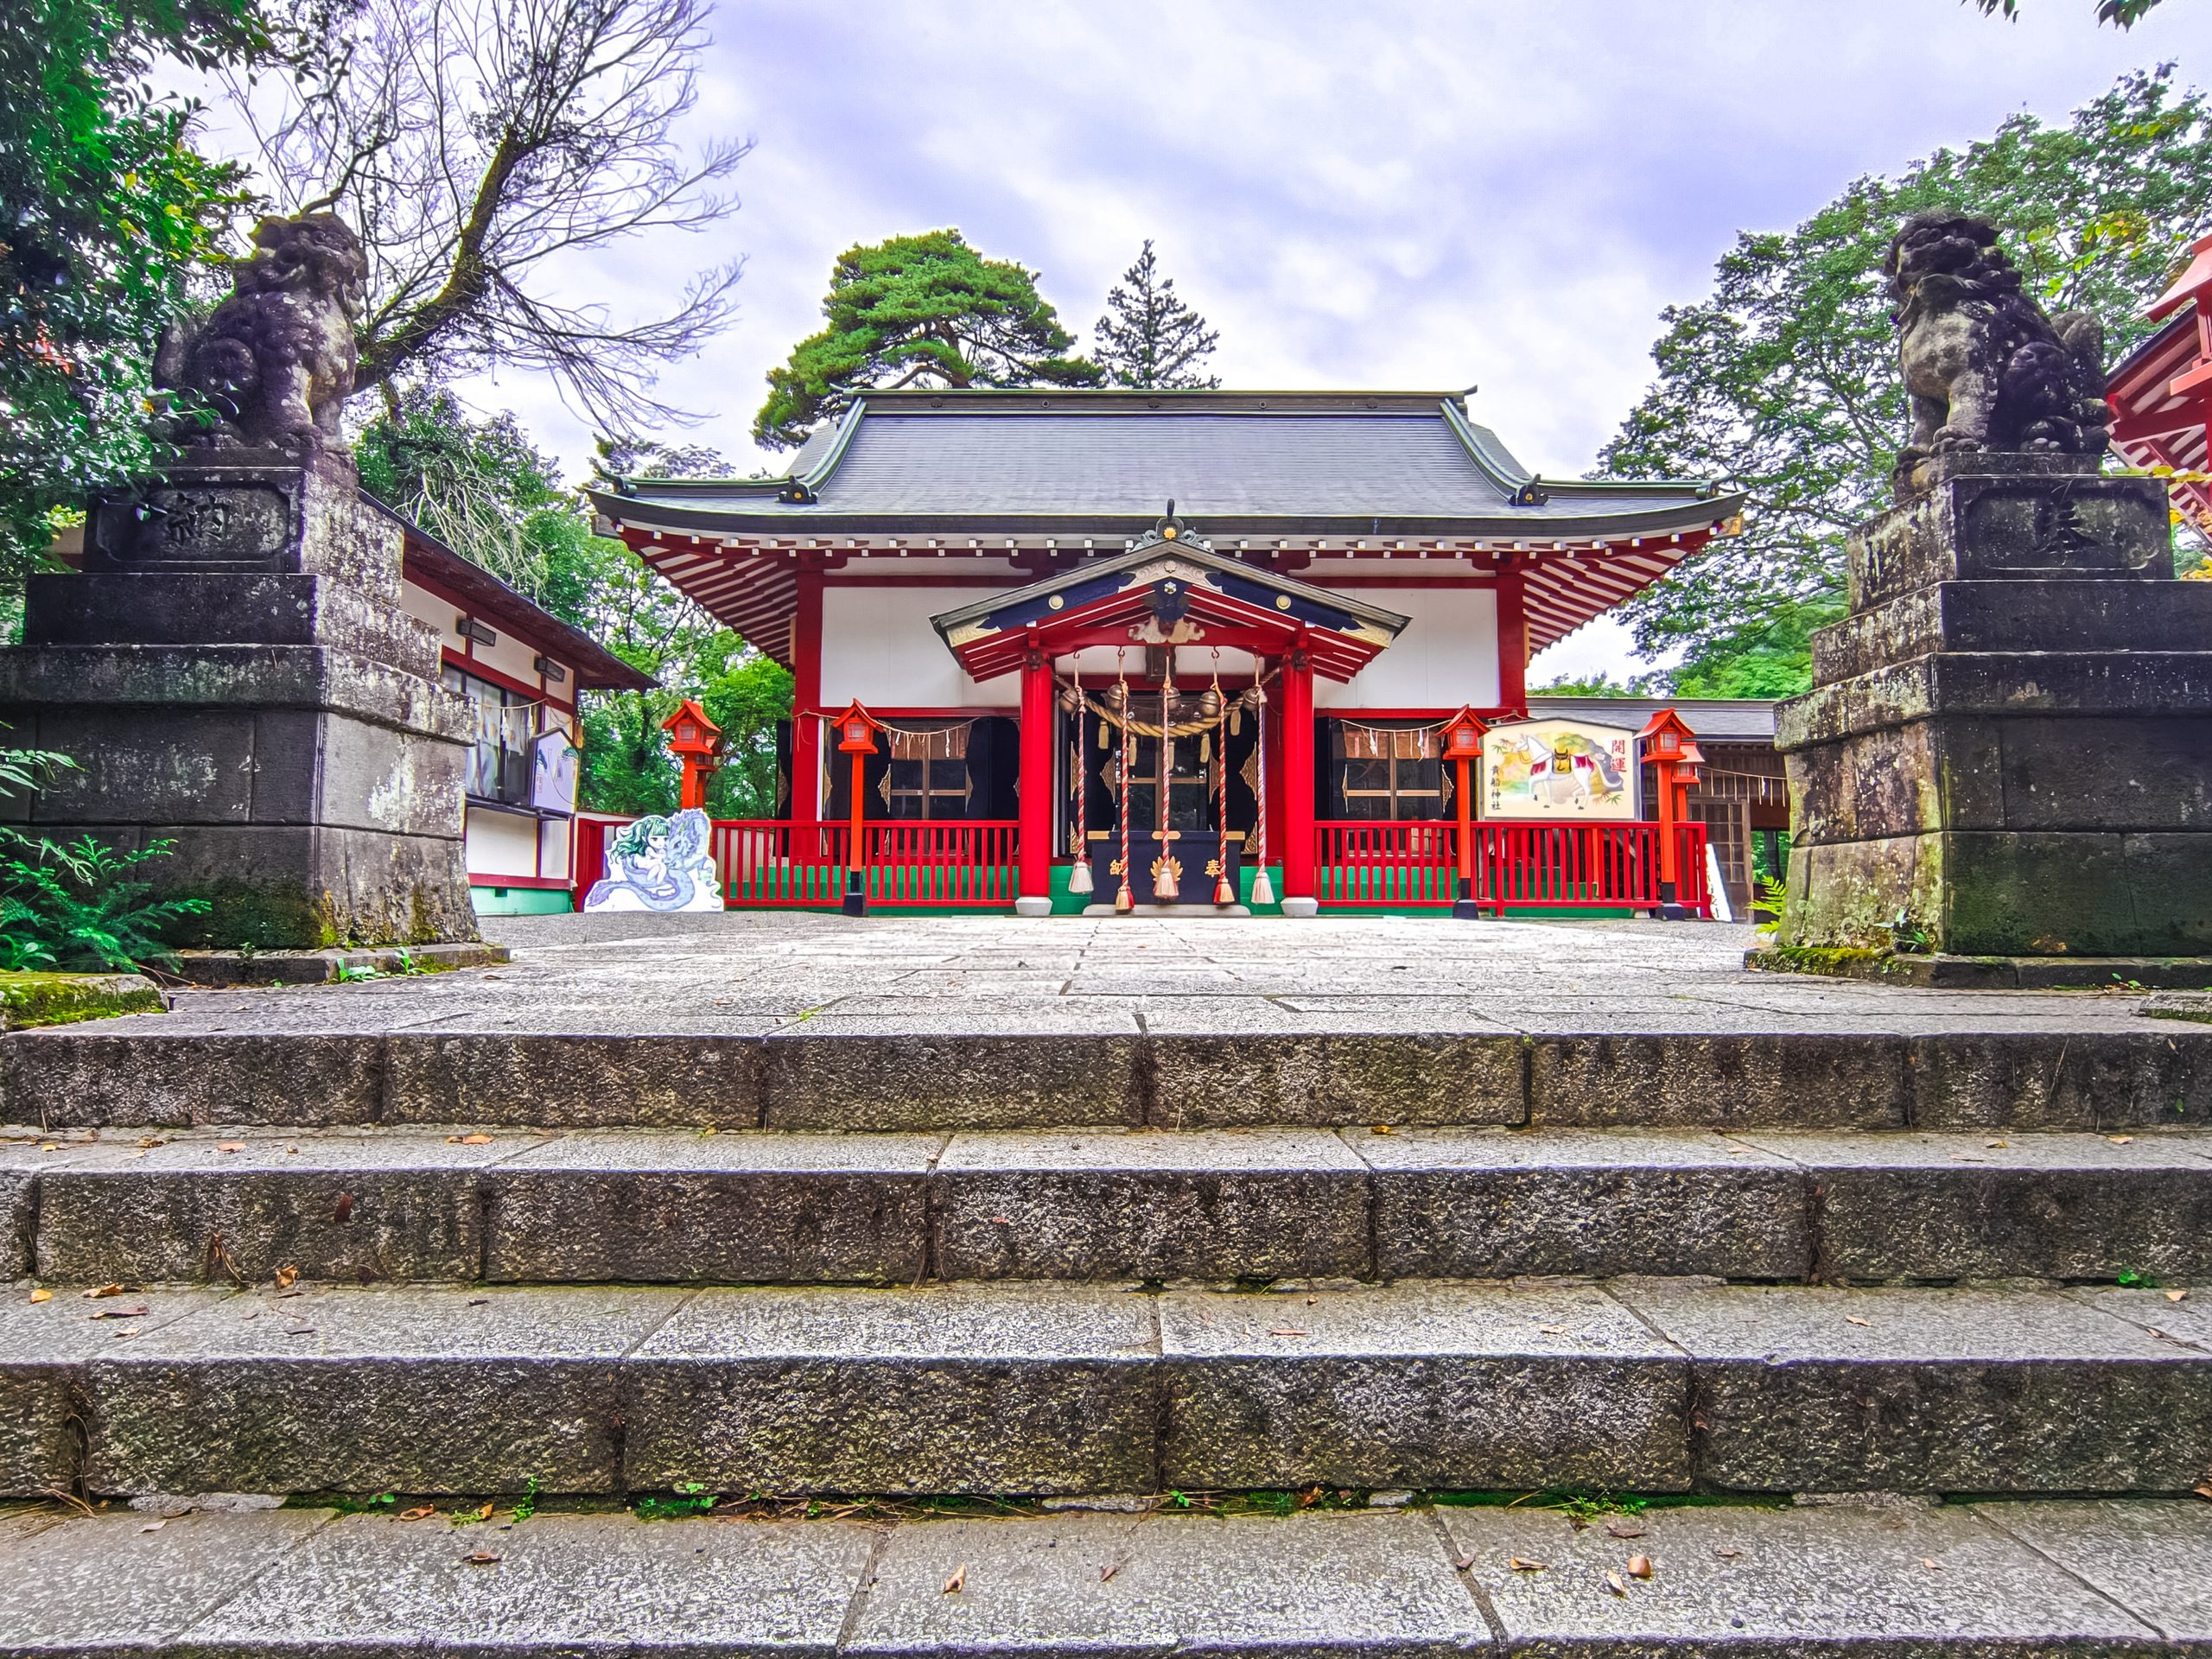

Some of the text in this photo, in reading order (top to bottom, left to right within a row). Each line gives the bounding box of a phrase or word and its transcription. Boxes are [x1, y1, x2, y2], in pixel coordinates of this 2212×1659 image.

[1610, 739, 1627, 773] 開運
[1490, 764, 1502, 811] 貴船神社
[1205, 859, 1221, 878] 奉
